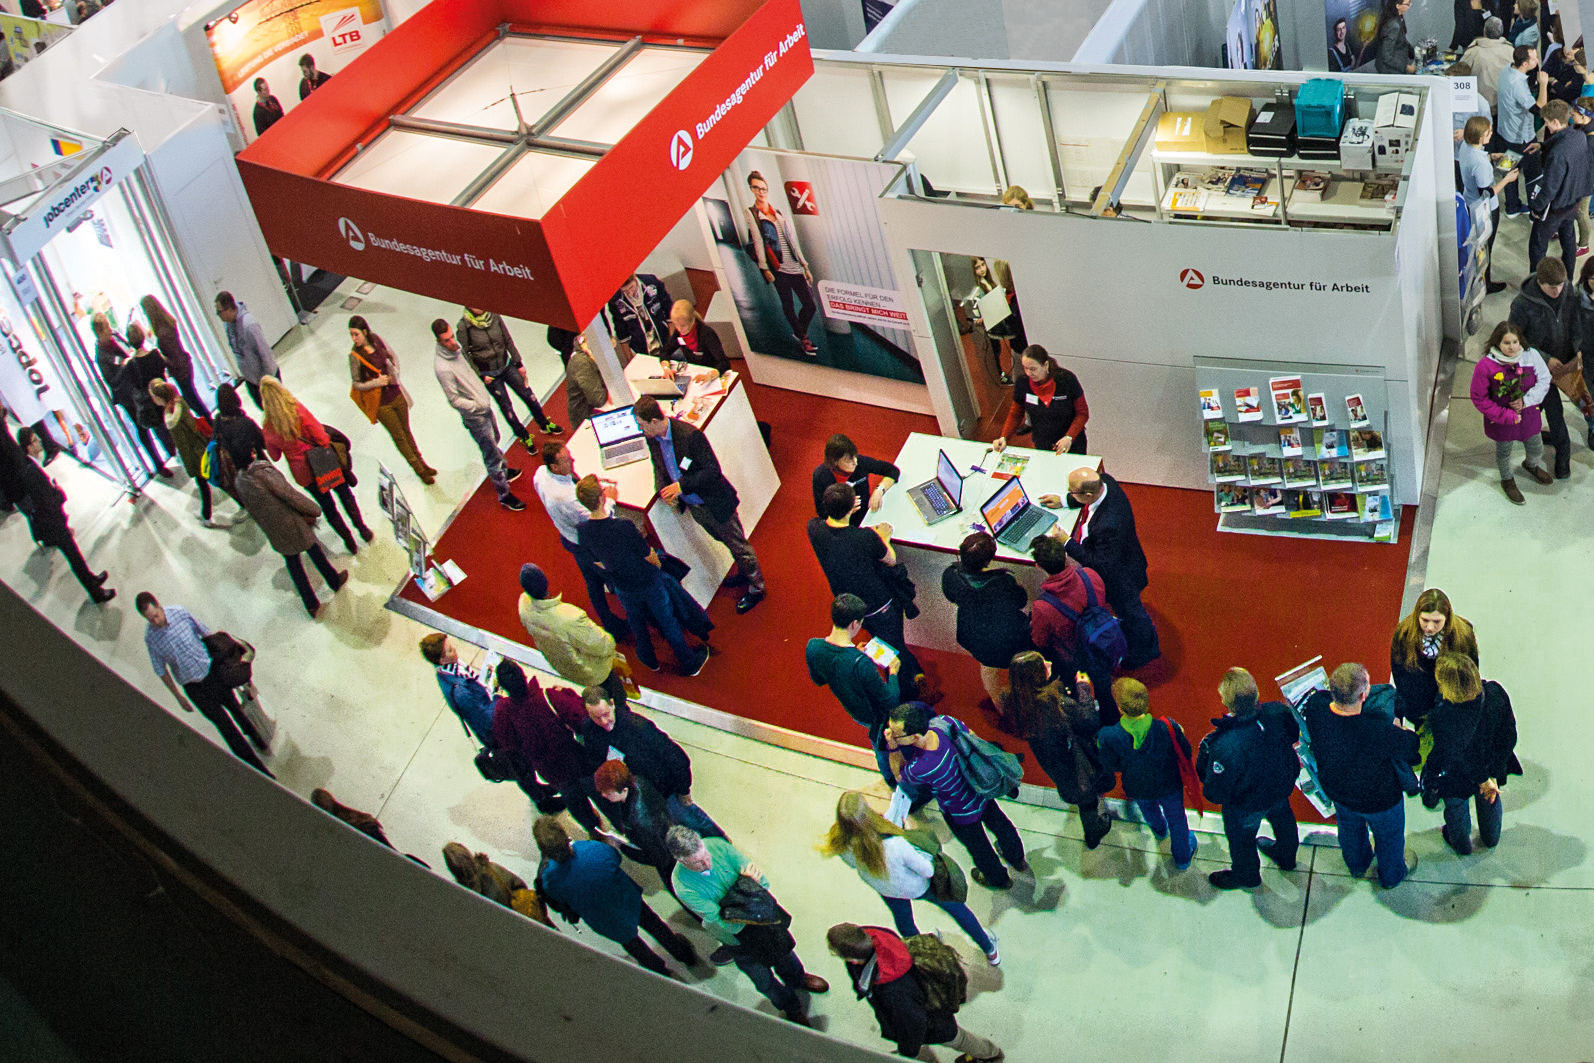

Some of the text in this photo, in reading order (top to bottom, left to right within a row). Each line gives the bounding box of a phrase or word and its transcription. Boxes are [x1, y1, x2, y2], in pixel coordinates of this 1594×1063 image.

[332, 29, 362, 47] LTB
[695, 23, 805, 140] Bundesagentur für Arbeit
[1454, 82, 1471, 90] 308
[43, 180, 92, 228] jobcenter
[367, 232, 535, 281] Bundesagentur für Arbeit
[1212, 275, 1371, 293] Bundesagentur für Arbeit
[825, 286, 894, 303] DIE FORMEL FÜR DEN
[826, 294, 880, 308] ERFOLG KENNEN
[830, 301, 845, 309] DAS
[845, 303, 870, 314] BRINGT
[870, 307, 889, 316] MICH
